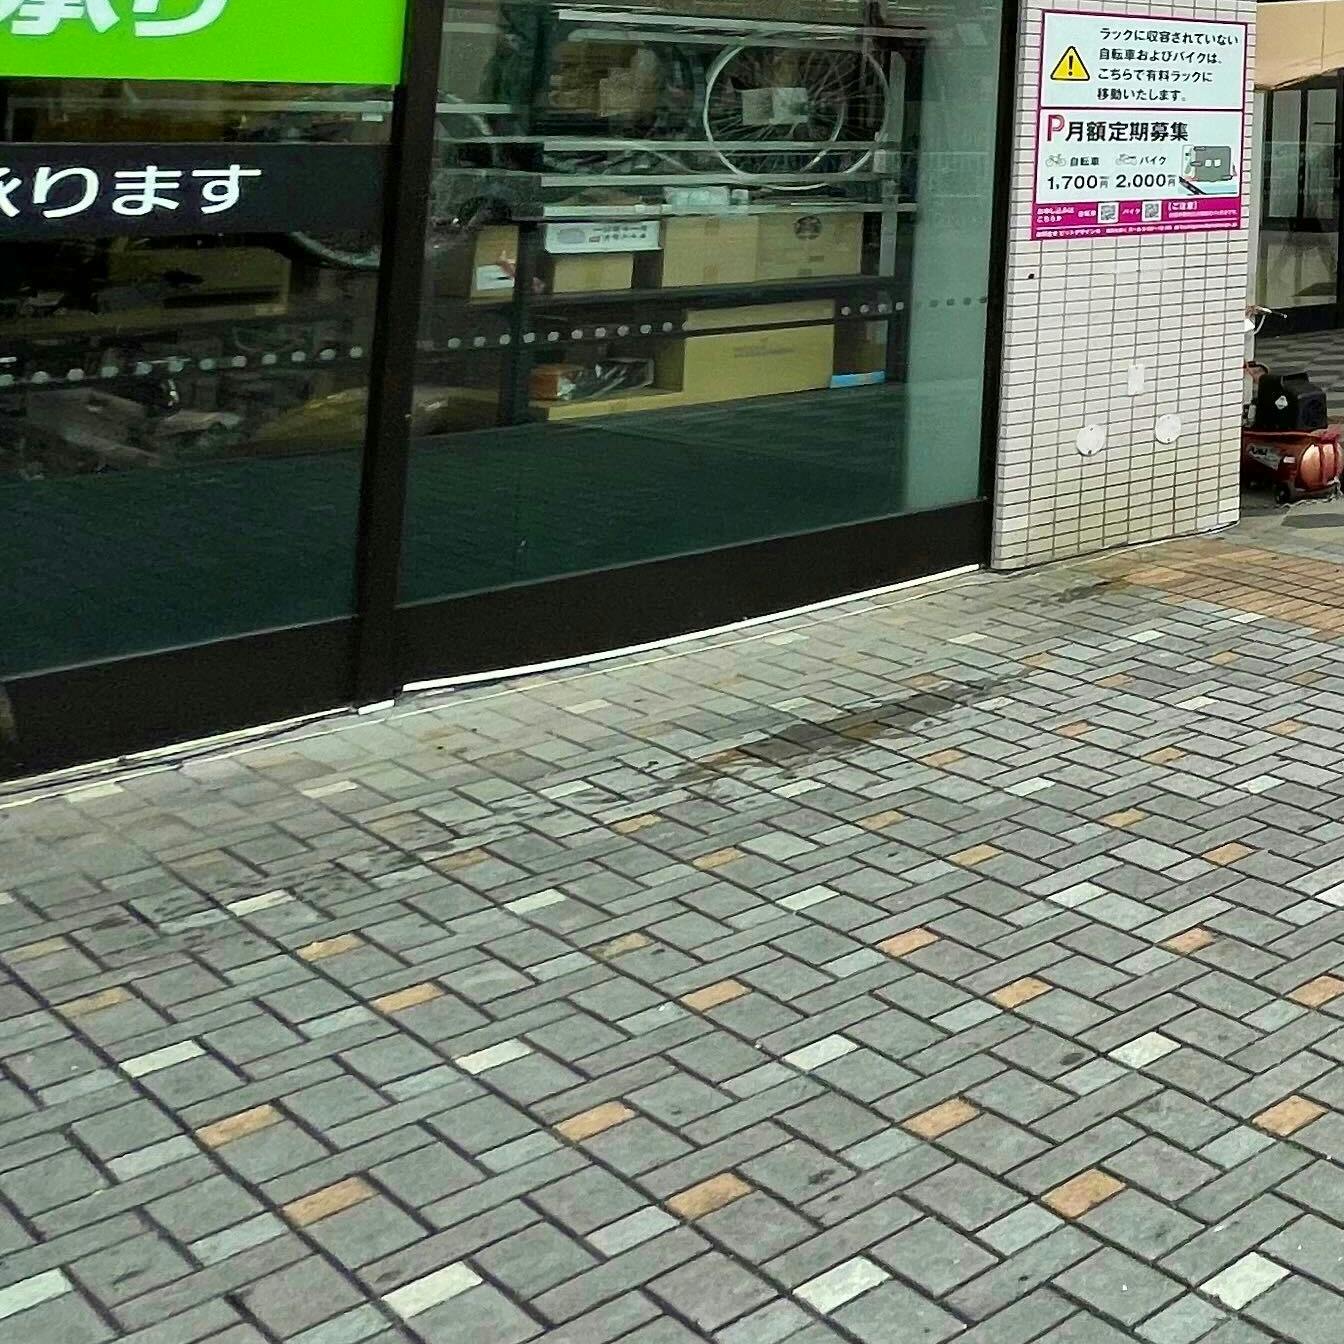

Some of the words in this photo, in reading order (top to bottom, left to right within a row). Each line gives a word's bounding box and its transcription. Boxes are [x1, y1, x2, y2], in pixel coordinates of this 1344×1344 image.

[1100, 28, 1239, 45] ラックに収容されていない
[1099, 48, 1223, 64] 自転車およびバイクは、
[1098, 68, 1213, 83] こちらで有料ラックに
[1097, 88, 1187, 102] 移動いたします。
[1139, 156, 1168, 167] バイク
